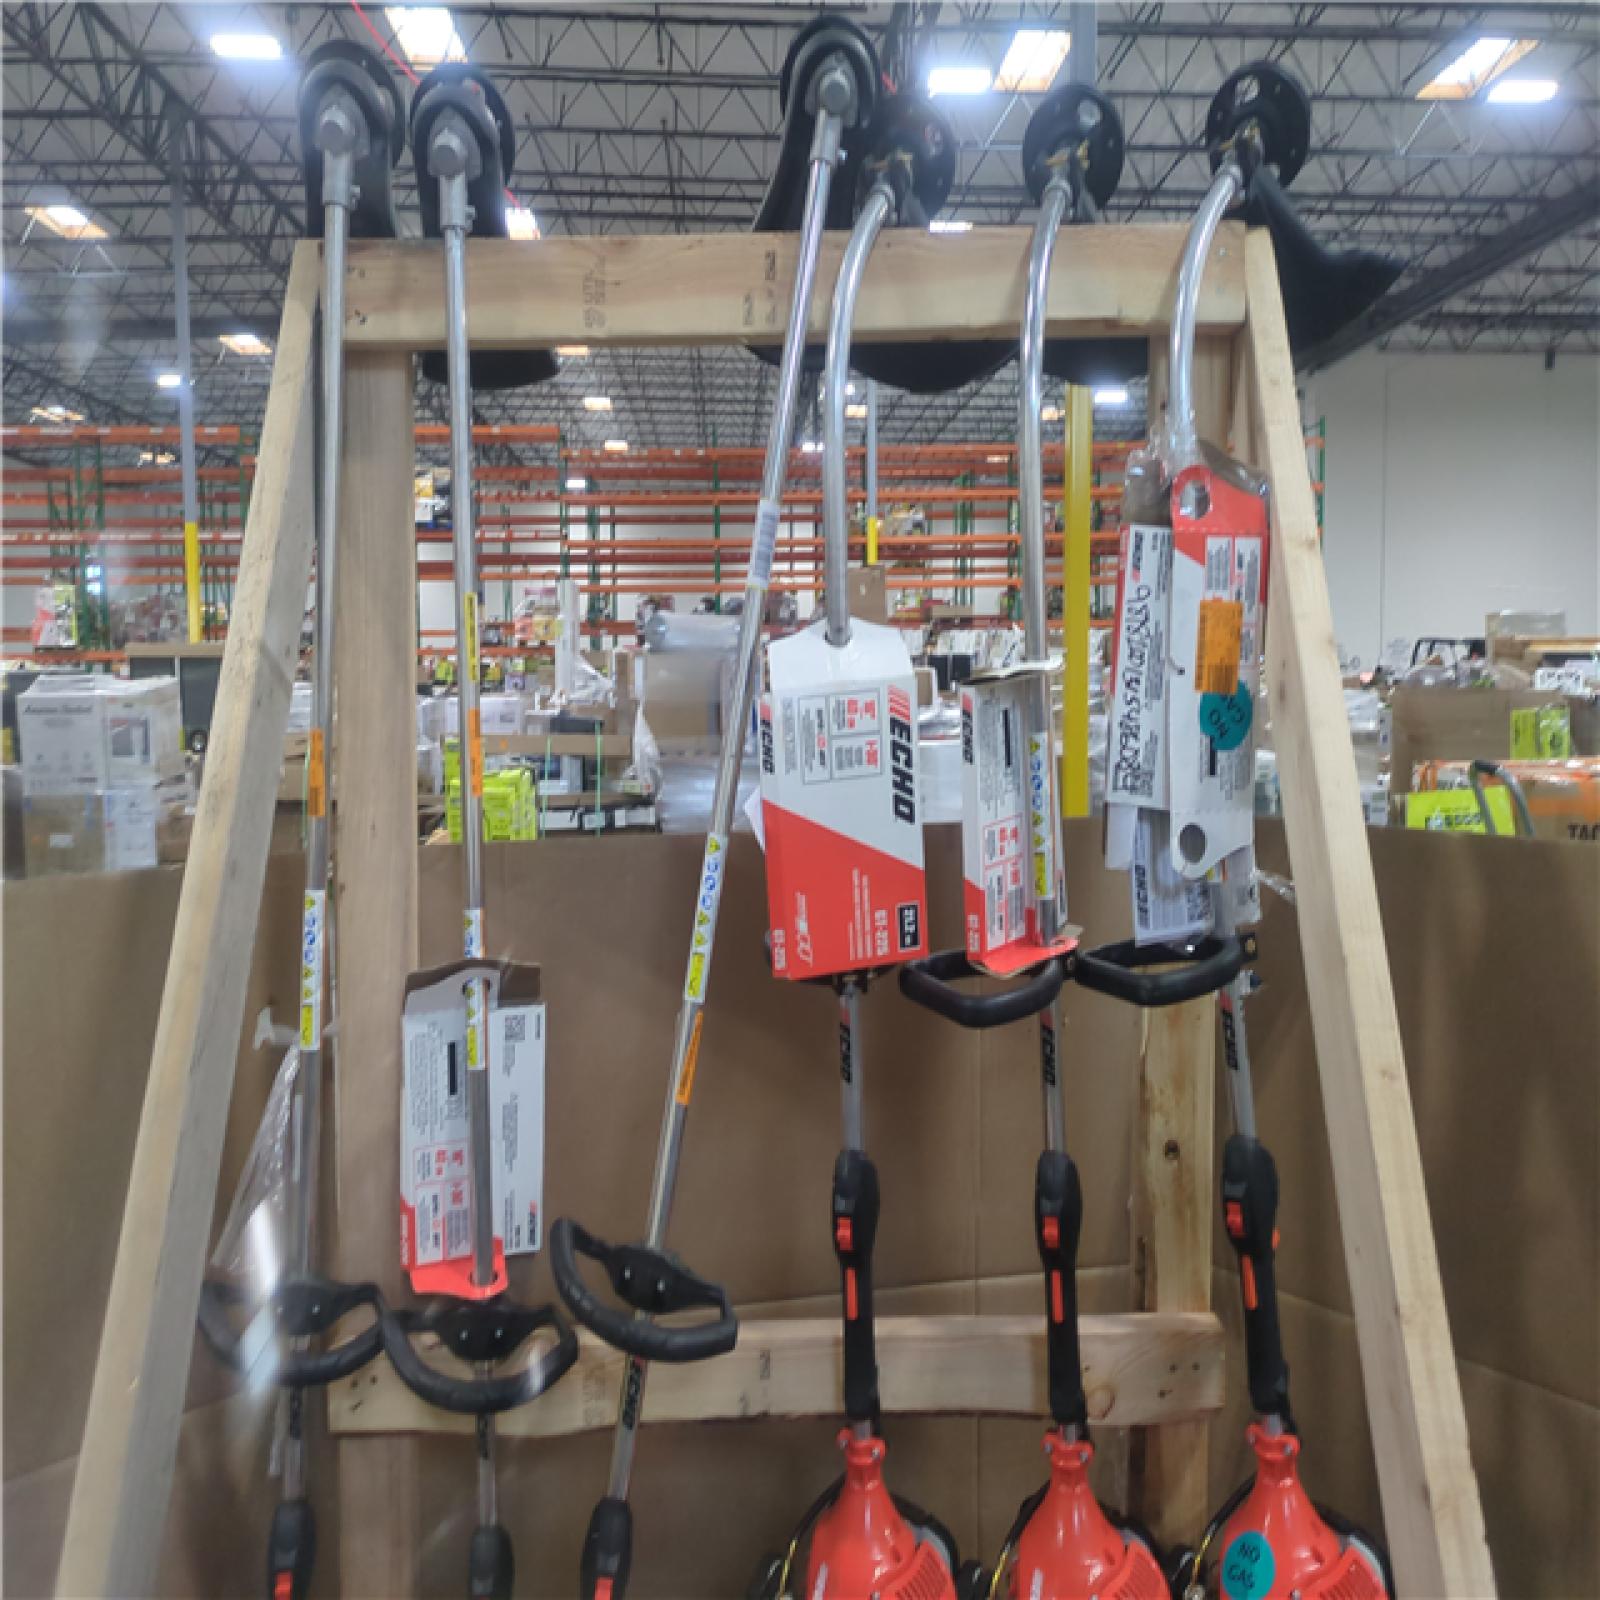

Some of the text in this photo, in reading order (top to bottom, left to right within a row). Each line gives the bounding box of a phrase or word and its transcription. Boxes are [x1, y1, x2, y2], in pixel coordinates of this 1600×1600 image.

[761, 718, 775, 775] ECHO
[889, 717, 915, 825] ECHO
[839, 1023, 852, 1083] ECHO
[1042, 1025, 1056, 1087] ECHO
[1228, 1565, 1253, 1590] GAS
[1239, 1542, 1261, 1563] NO
